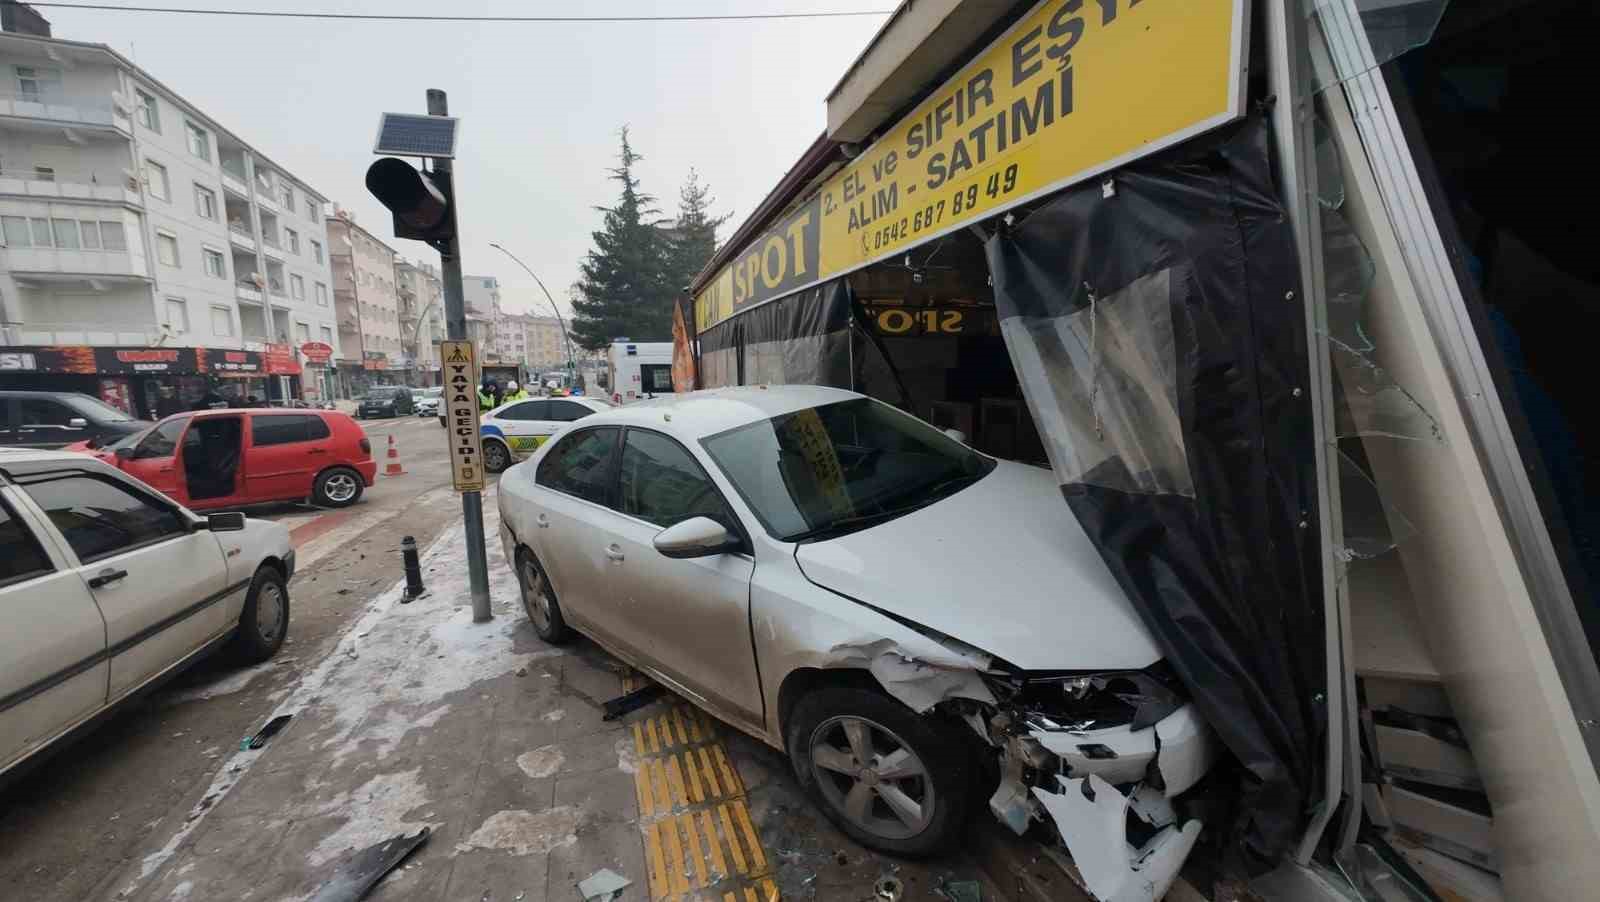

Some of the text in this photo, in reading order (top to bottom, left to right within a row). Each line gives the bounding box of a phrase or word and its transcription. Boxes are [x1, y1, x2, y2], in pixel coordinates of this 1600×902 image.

[824, 0, 1143, 216] 2. EL ve SIFIR EŞ
[847, 182, 898, 234] ALIM
[874, 163, 1018, 249] 0542 687 89 49
[735, 210, 811, 304] SPOT
[451, 365, 470, 402] YAYA
